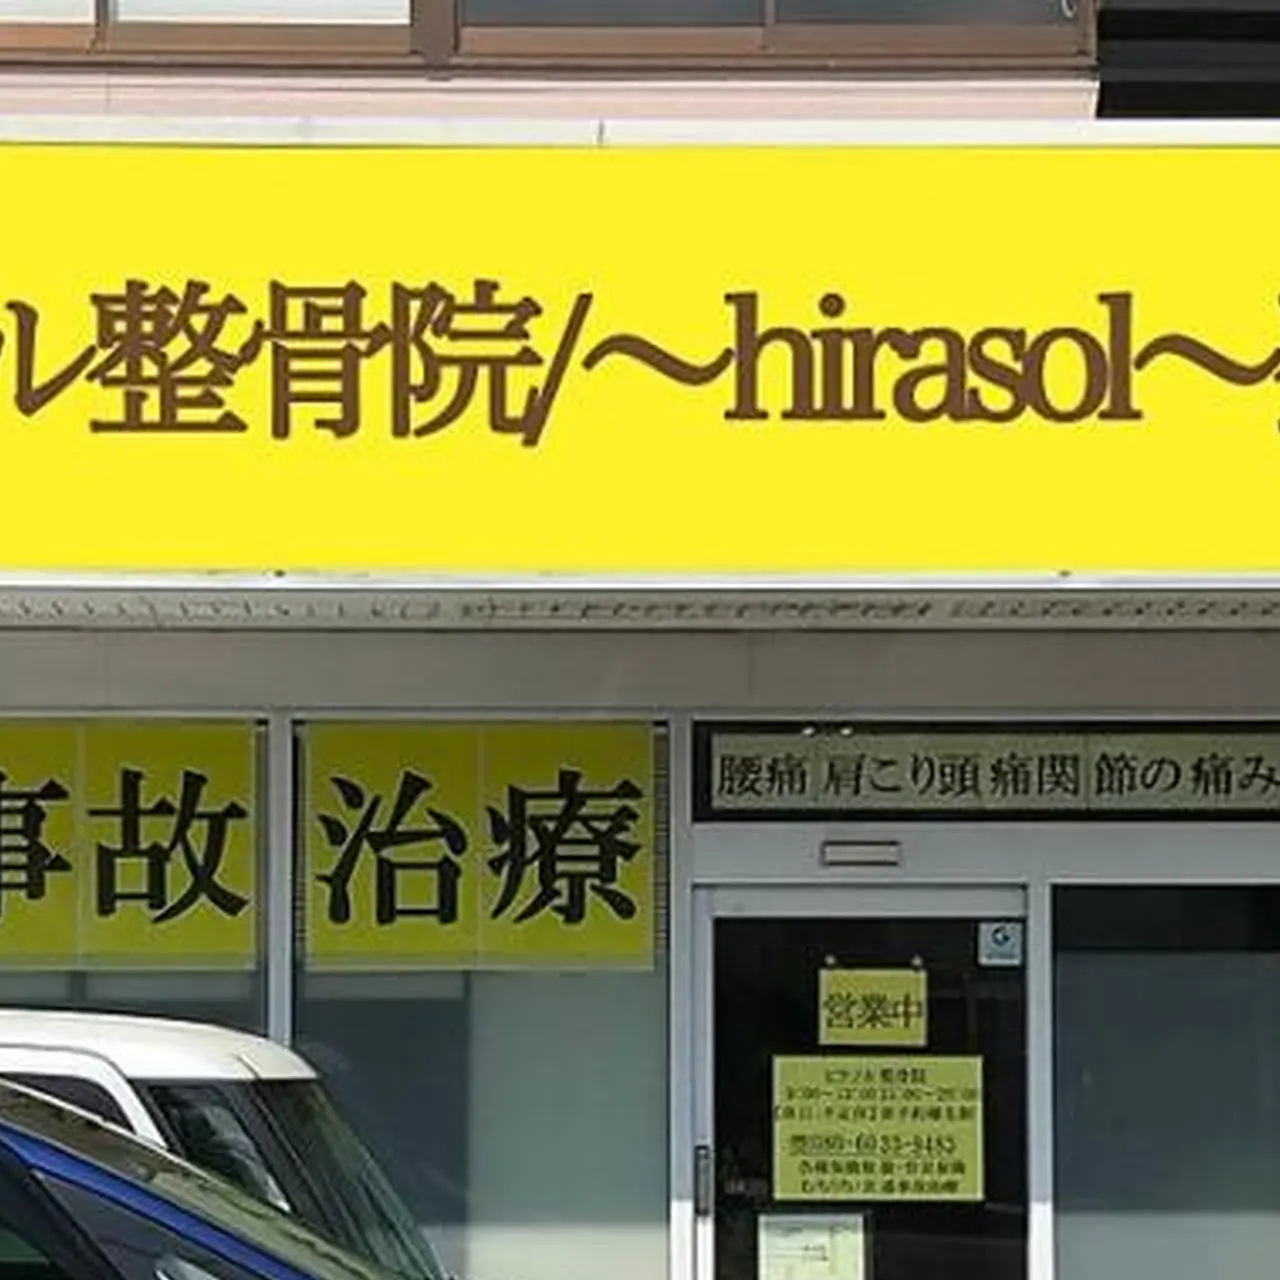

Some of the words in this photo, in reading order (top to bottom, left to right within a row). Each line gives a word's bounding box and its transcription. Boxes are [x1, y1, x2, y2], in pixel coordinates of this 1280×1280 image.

[316, 766, 644, 927] 治療
[823, 992, 924, 1030] 営業中
